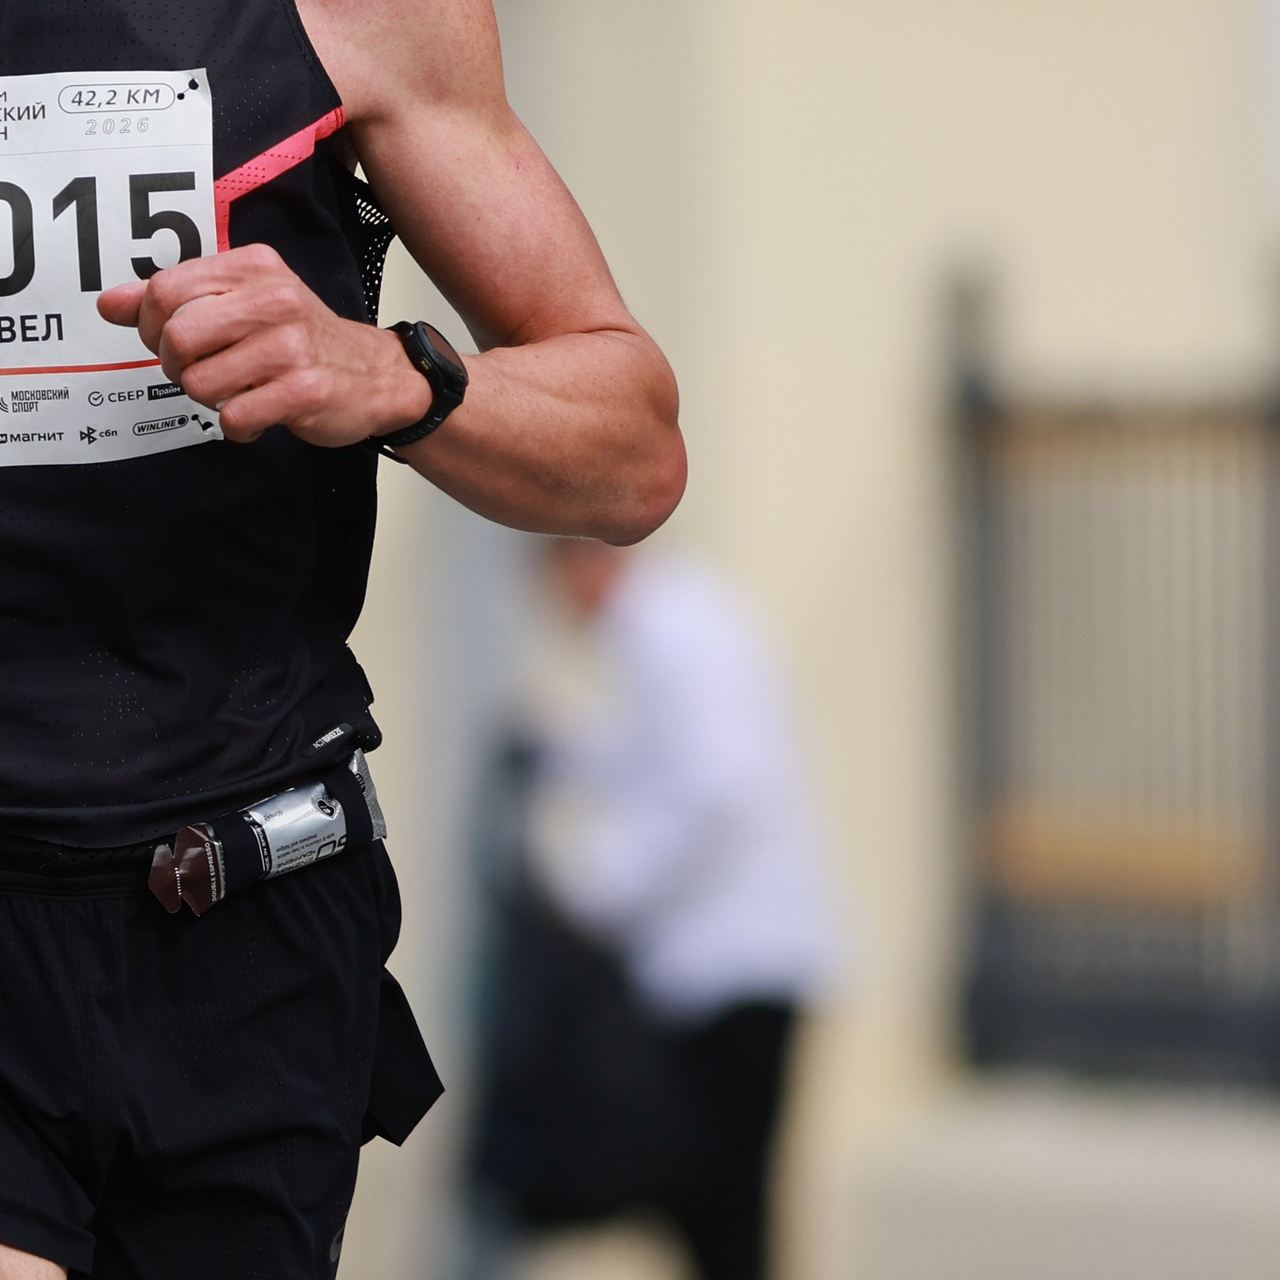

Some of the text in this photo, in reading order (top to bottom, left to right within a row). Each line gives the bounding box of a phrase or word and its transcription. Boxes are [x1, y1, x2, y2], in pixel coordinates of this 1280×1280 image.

[71, 89, 118, 108] 42,2
[84, 117, 150, 136] 2026
[10, 386, 70, 402] МОСКОВСКИЙ
[107, 385, 181, 403] СБЕР Прайм
[11, 401, 39, 413] СПОРТ
[98, 428, 118, 438] сбп
[137, 419, 177, 433] WINLINE
[9, 431, 65, 443] магнит
[204, 842, 216, 876] ESPRESSO
